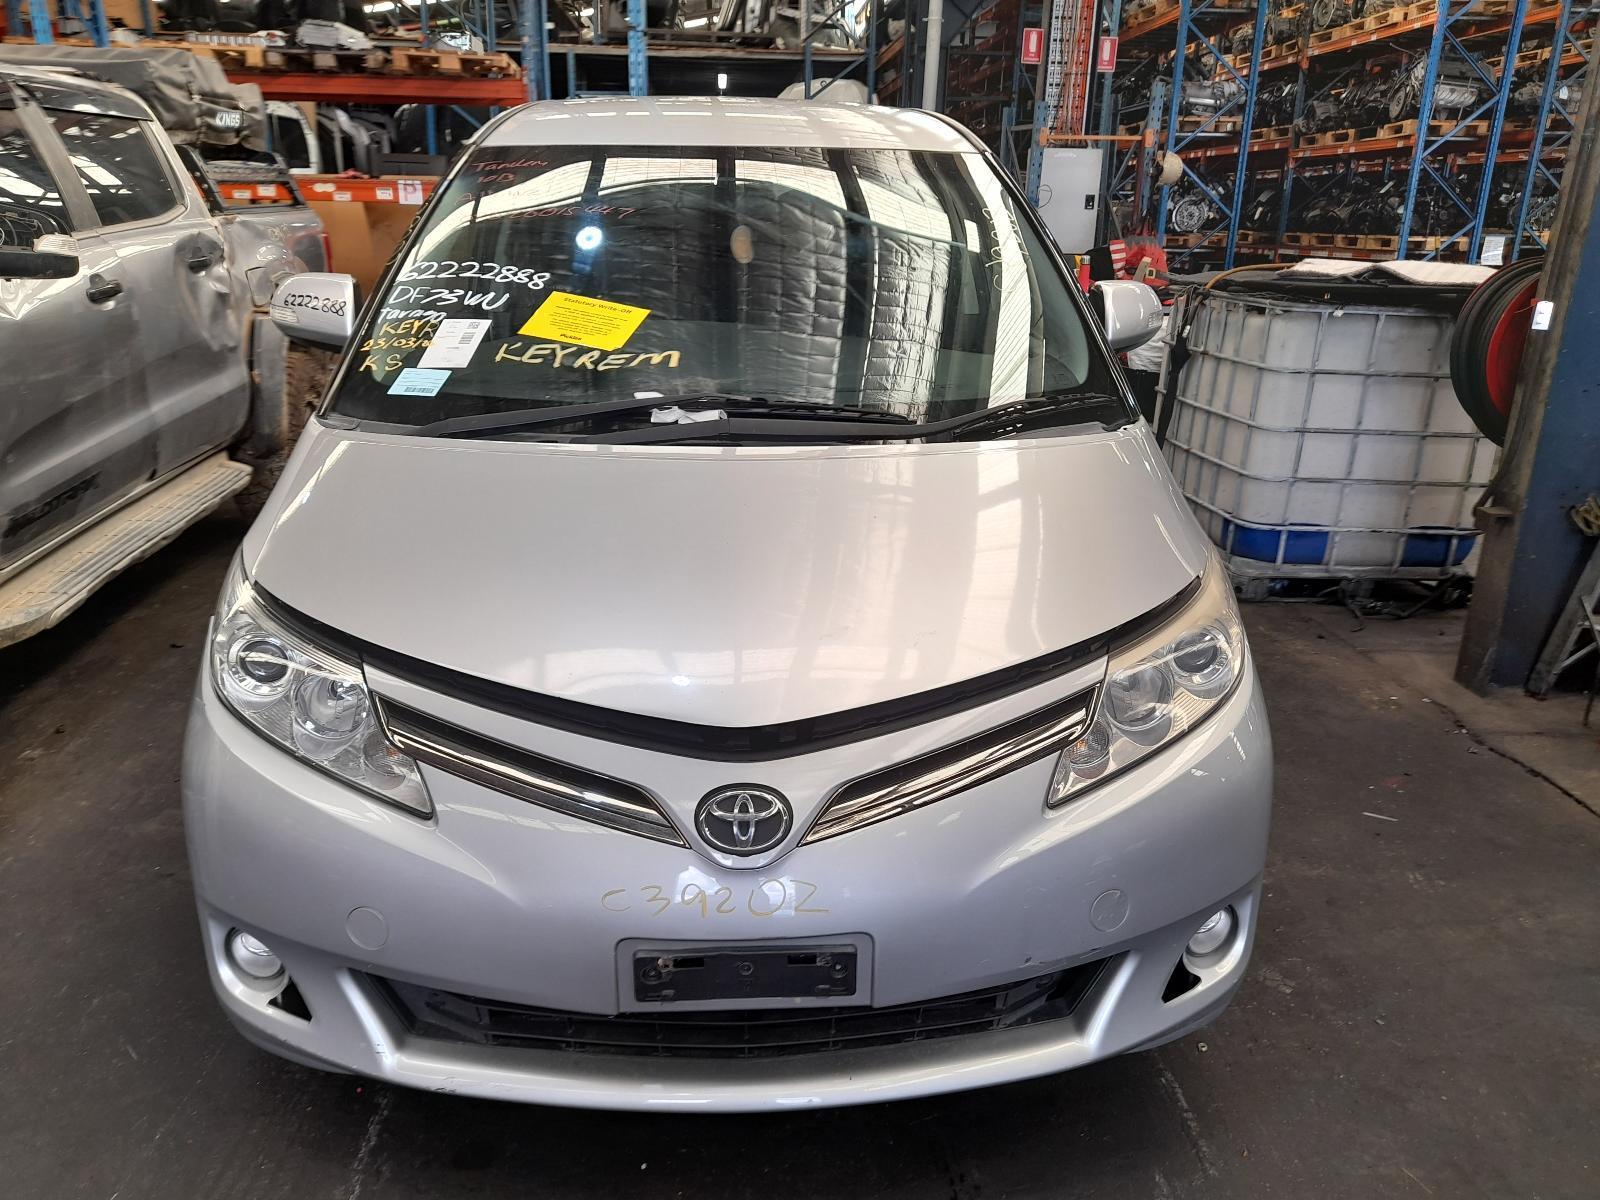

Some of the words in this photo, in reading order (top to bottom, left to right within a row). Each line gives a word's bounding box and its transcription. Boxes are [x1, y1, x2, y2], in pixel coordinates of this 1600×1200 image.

[215, 111, 241, 127] KINGS
[393, 261, 551, 289] 62222888
[283, 293, 347, 316] 62222888
